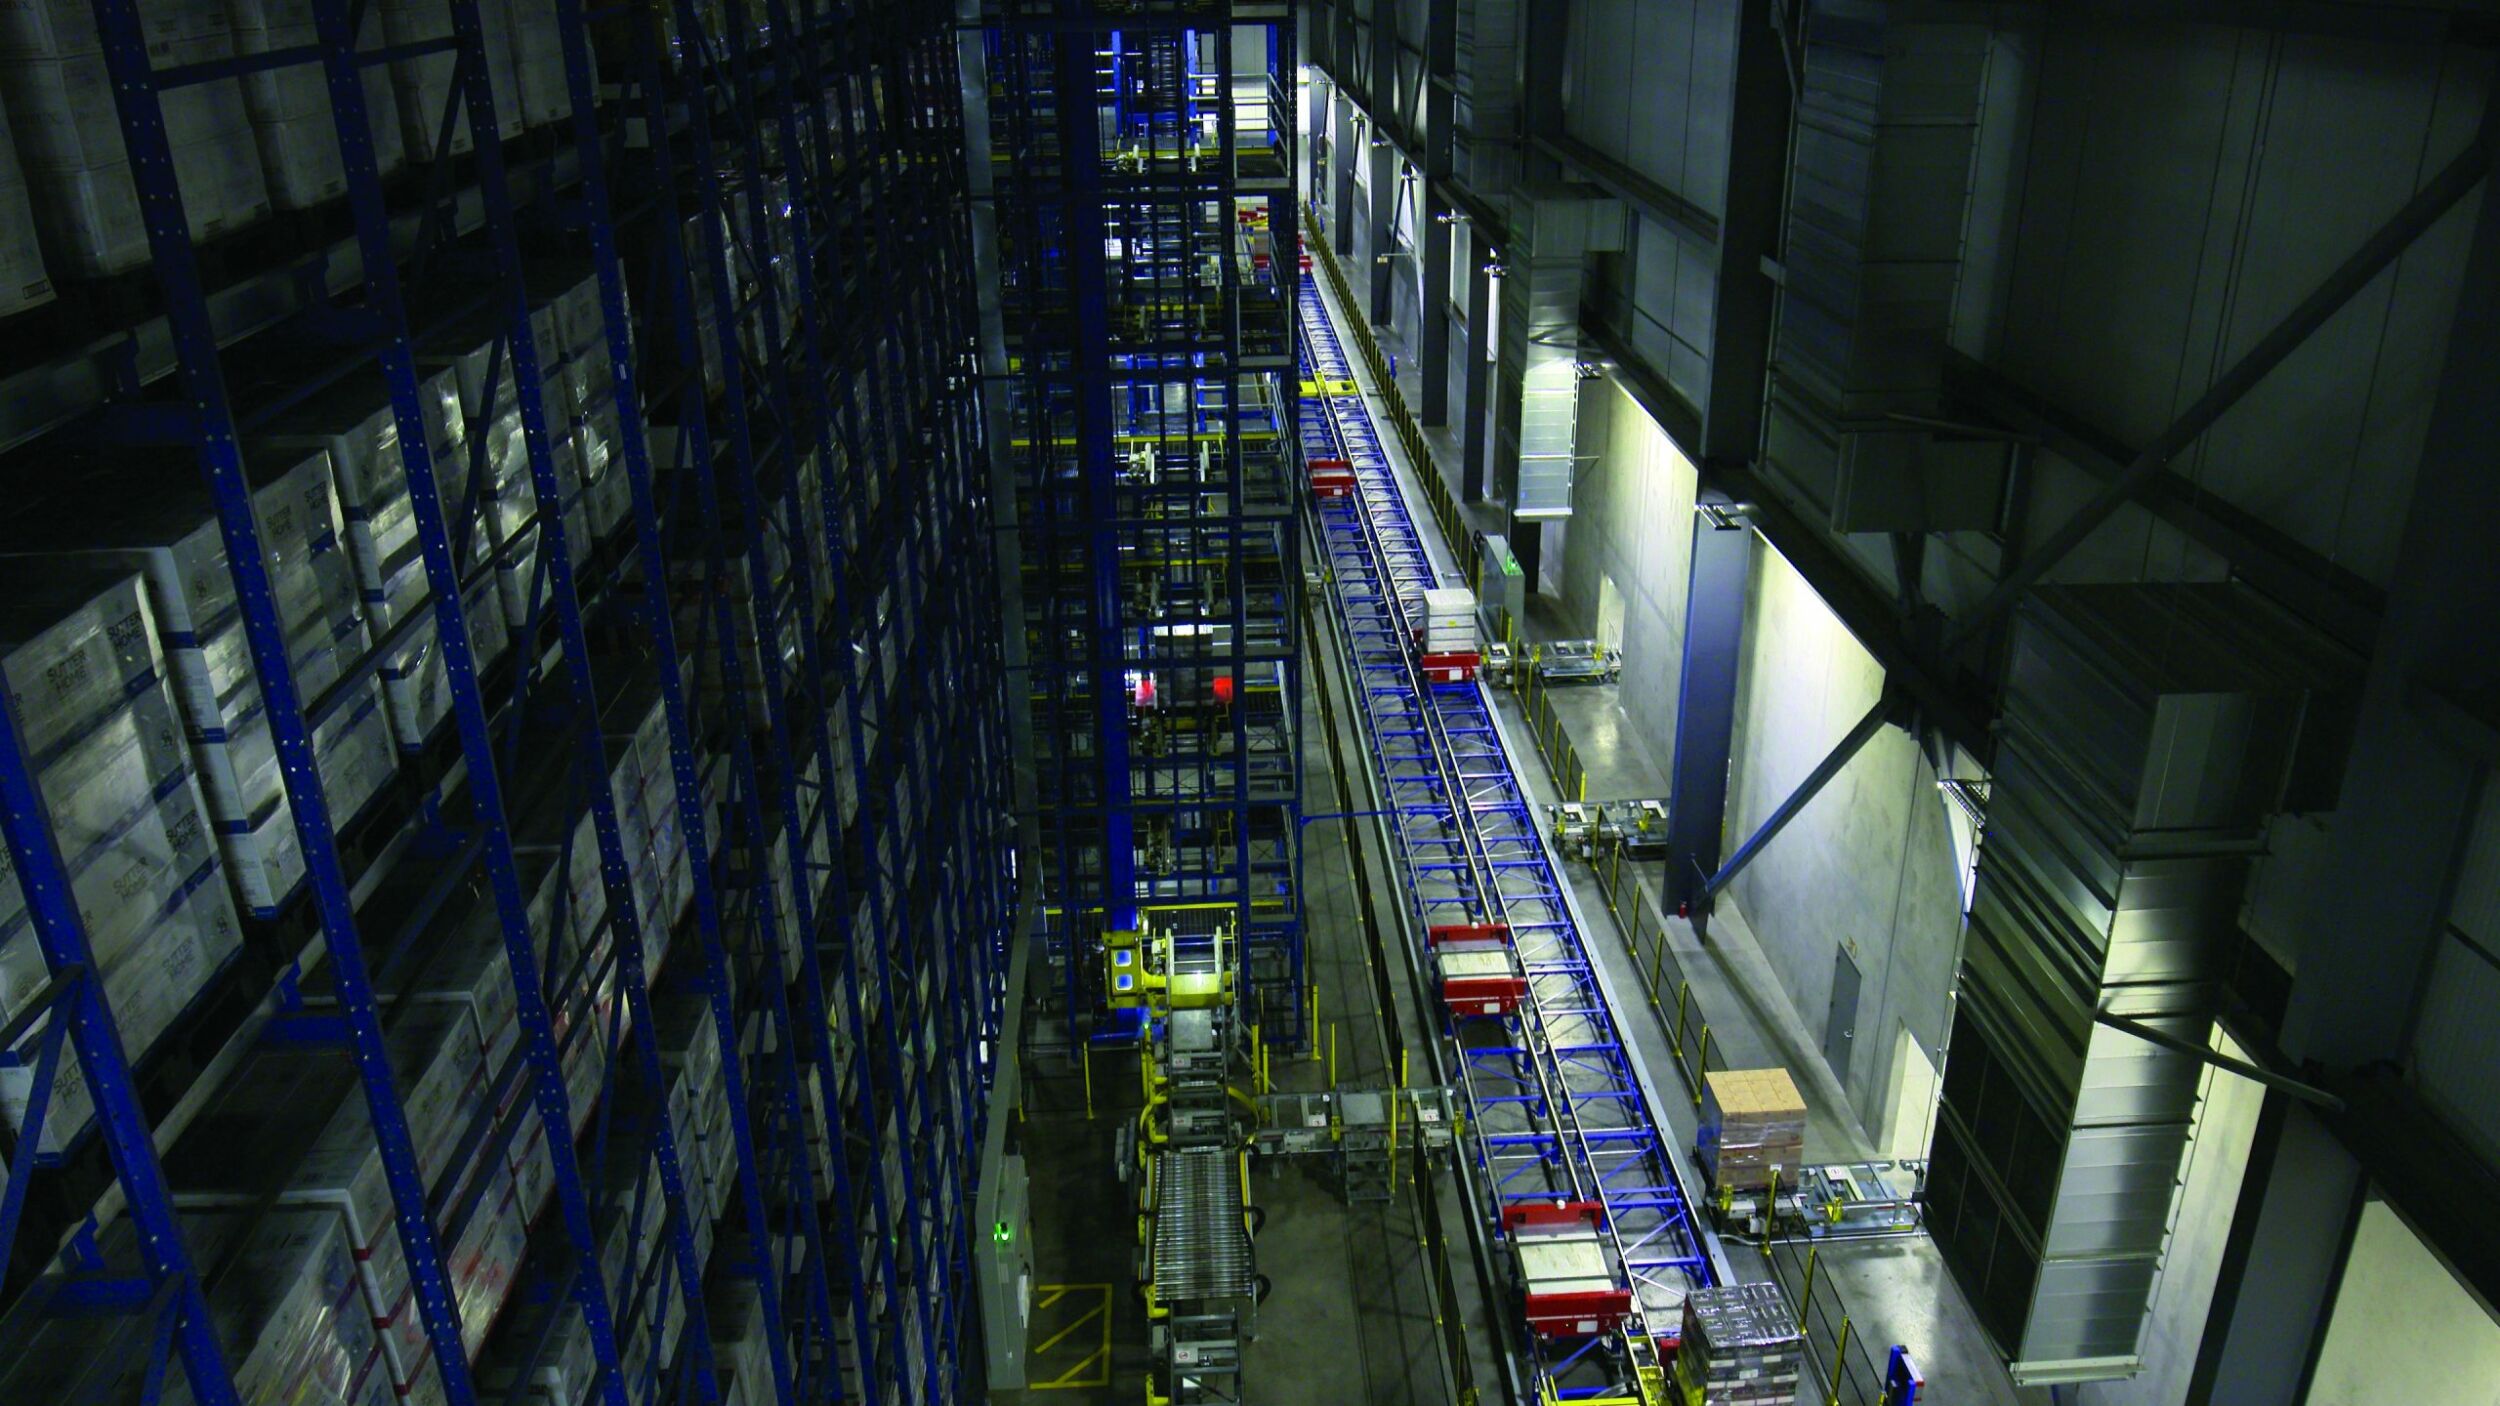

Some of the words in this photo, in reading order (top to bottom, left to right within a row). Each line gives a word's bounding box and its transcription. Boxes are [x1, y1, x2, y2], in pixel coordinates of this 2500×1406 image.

[107, 610, 142, 640] SUTTER
[114, 624, 143, 652] HOME
[47, 650, 86, 683] SUTTER
[56, 666, 88, 693] HOME
[166, 808, 199, 843] SUTTER
[113, 856, 149, 895] SUTTER
[53, 1060, 80, 1095] SUTT
